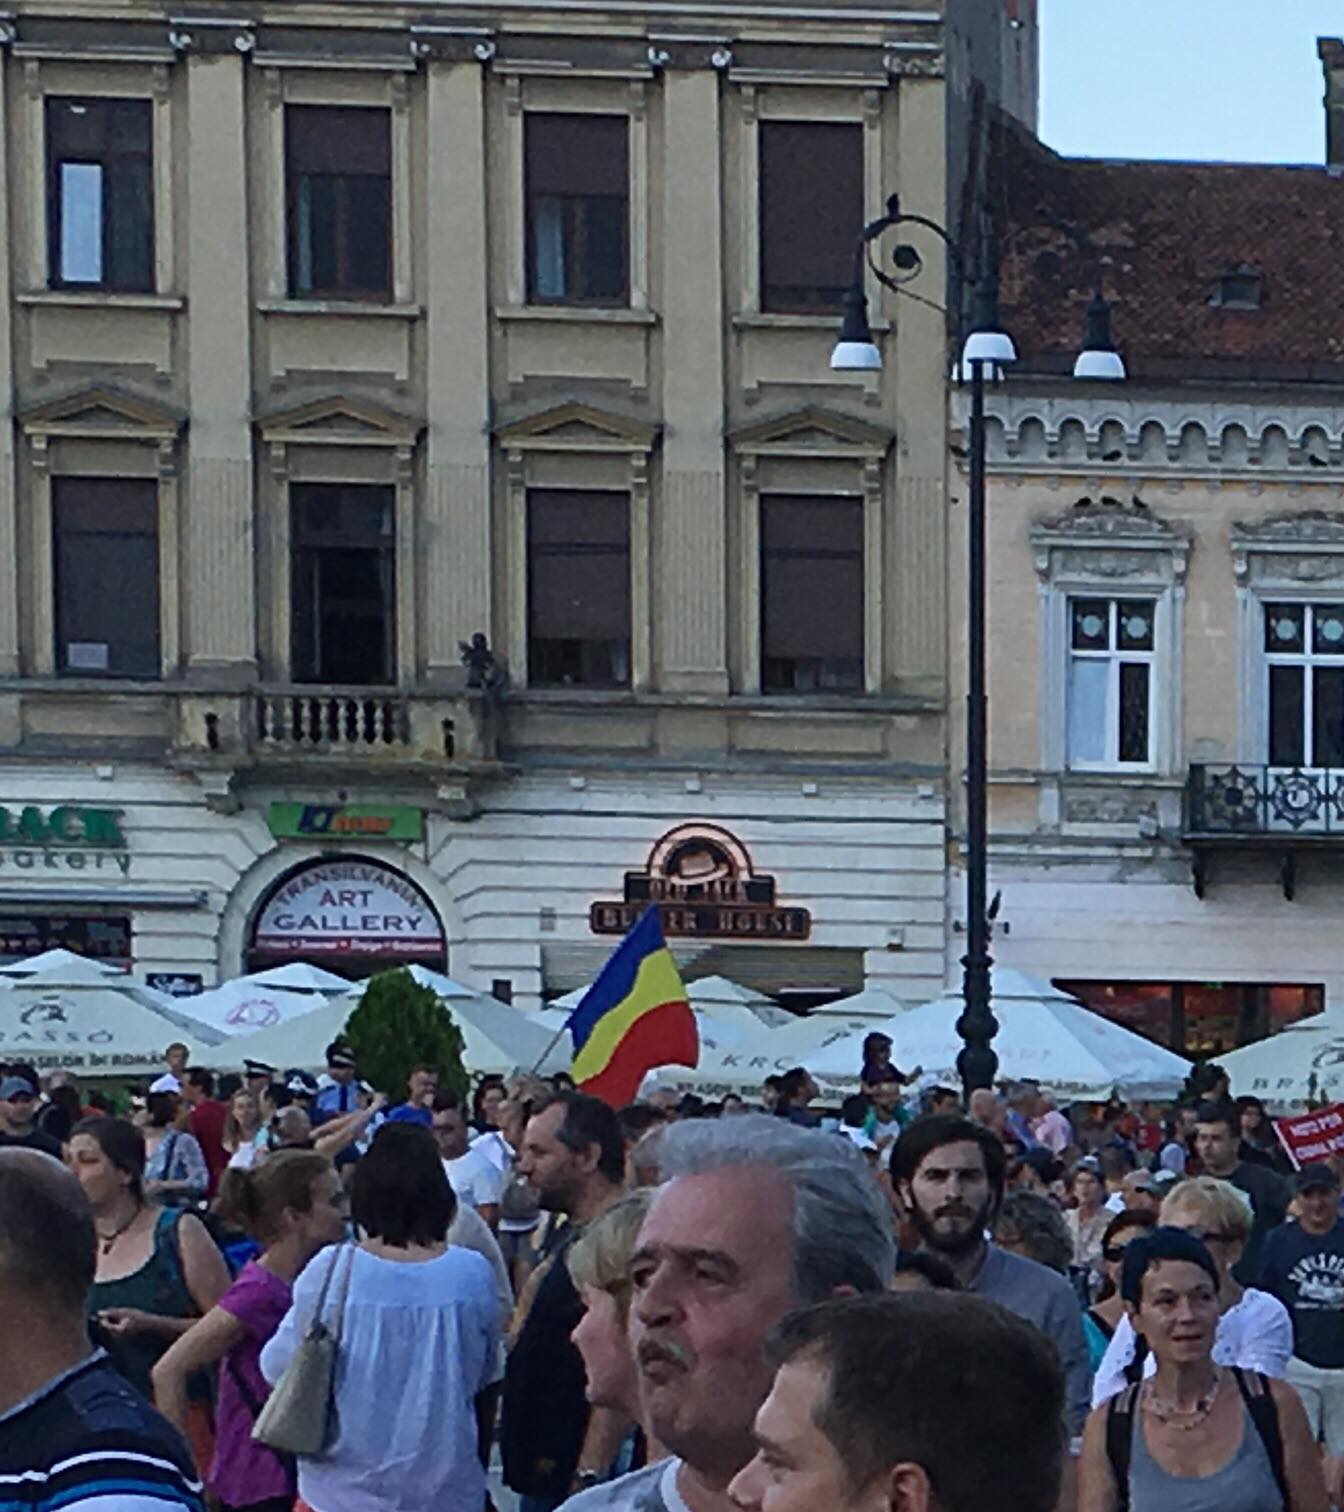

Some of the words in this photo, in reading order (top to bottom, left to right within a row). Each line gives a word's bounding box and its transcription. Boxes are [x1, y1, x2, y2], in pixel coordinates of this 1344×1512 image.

[0, 844, 131, 879] akery
[319, 889, 374, 907] ART
[273, 913, 422, 931] GALLERY
